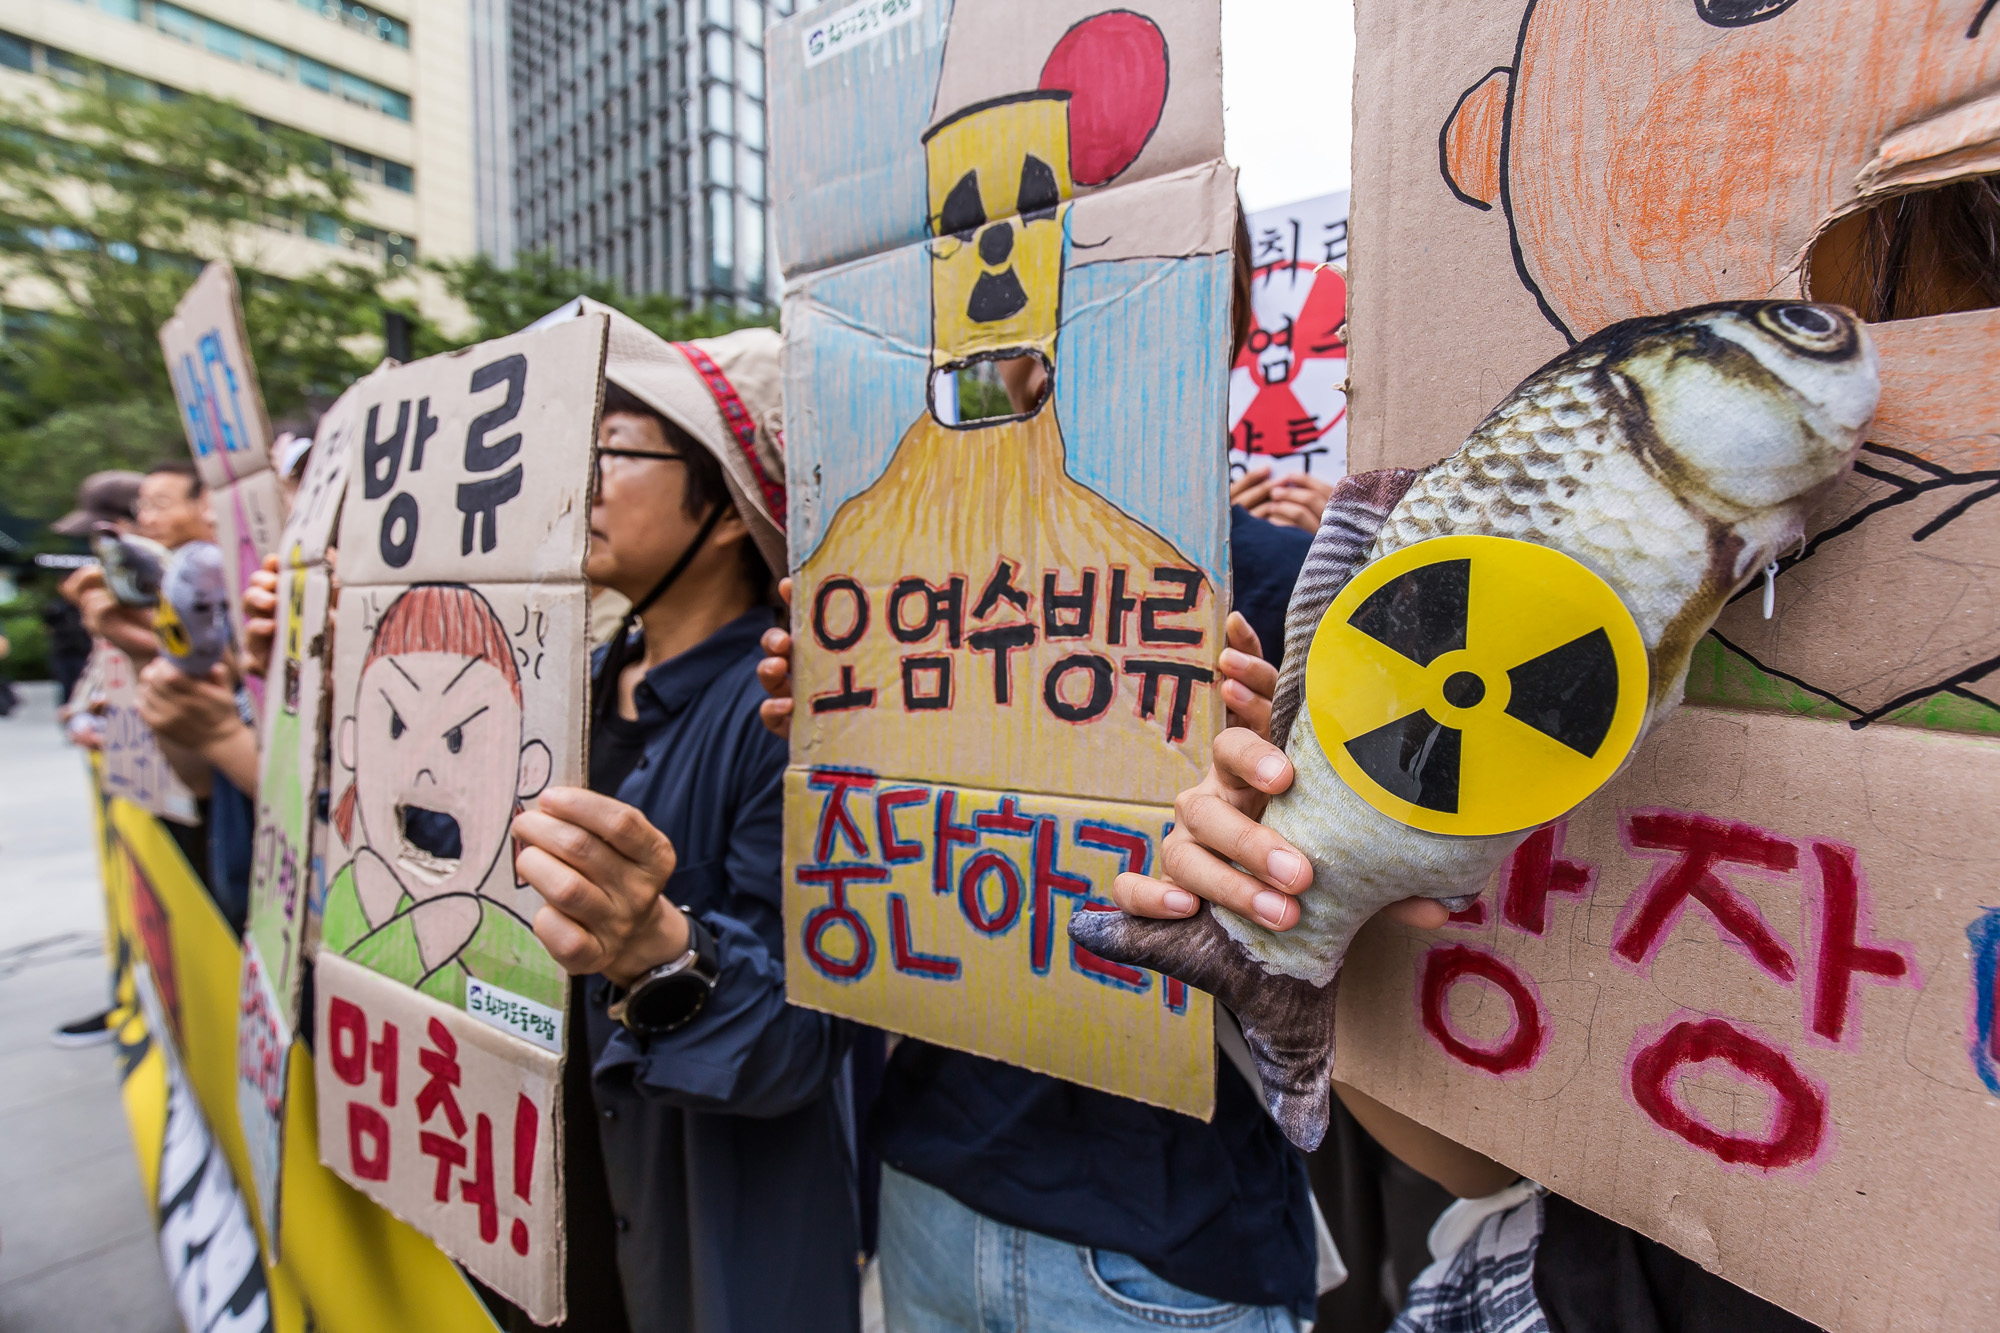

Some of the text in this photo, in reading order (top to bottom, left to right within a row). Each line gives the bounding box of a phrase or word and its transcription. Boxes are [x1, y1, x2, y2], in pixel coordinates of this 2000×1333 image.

[363, 353, 528, 568] 방류
[811, 556, 1217, 743] 오염수방류
[328, 995, 539, 1257] 멈춰!
